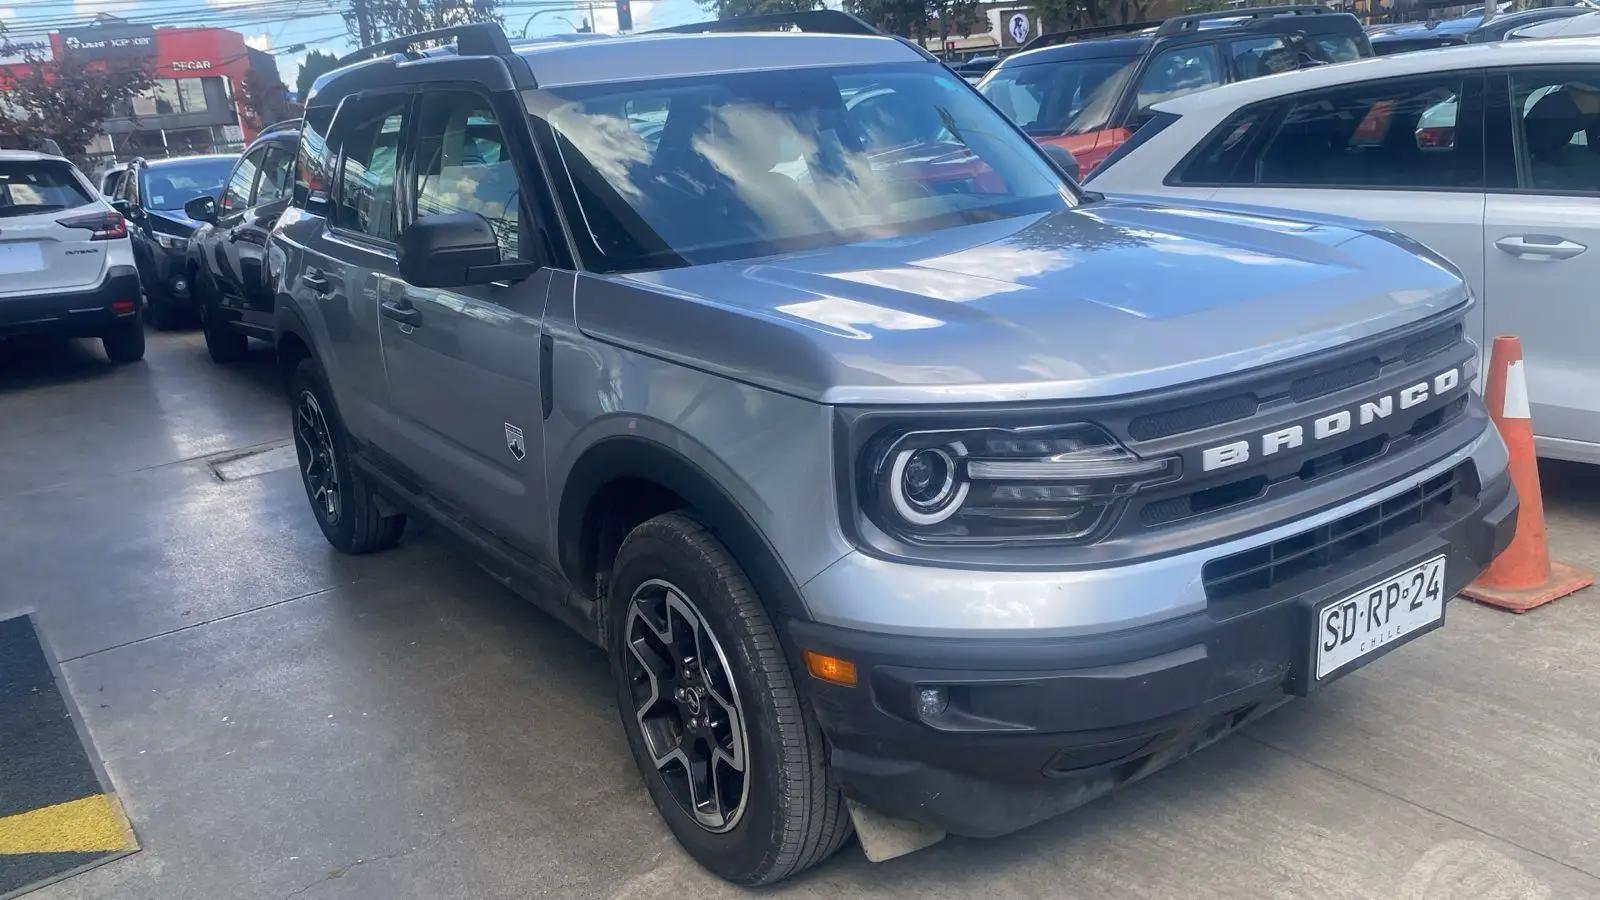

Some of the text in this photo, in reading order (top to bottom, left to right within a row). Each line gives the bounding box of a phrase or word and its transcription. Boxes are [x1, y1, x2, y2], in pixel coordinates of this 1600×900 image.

[172, 60, 211, 71] DECAR
[1202, 368, 1459, 472] BRONCO
[1360, 625, 1401, 652] CHILE
